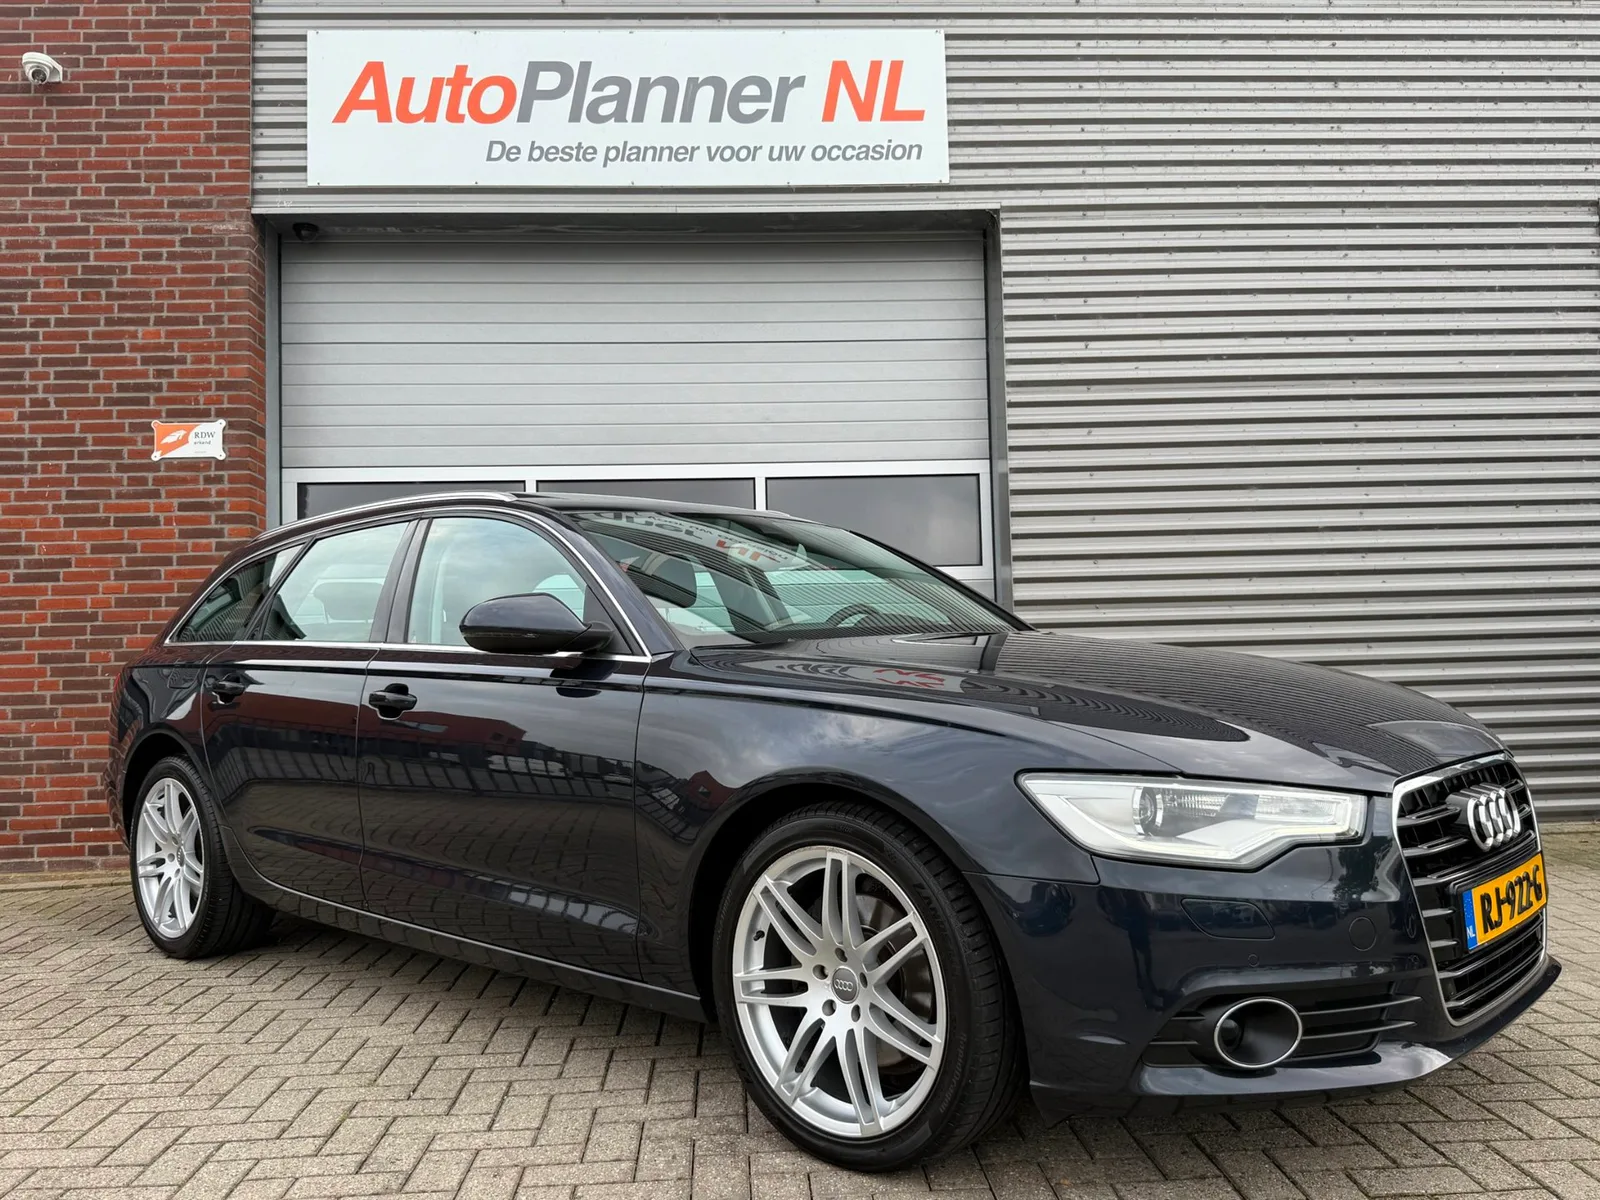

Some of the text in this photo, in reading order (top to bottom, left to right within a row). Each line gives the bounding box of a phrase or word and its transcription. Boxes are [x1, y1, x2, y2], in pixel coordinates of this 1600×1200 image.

[332, 60, 926, 124] AutoPlanner NL
[486, 139, 923, 168] De beste planner voor uw occasion
[1480, 865, 1542, 933] RJ-922-G
[1467, 926, 1475, 938] NL
